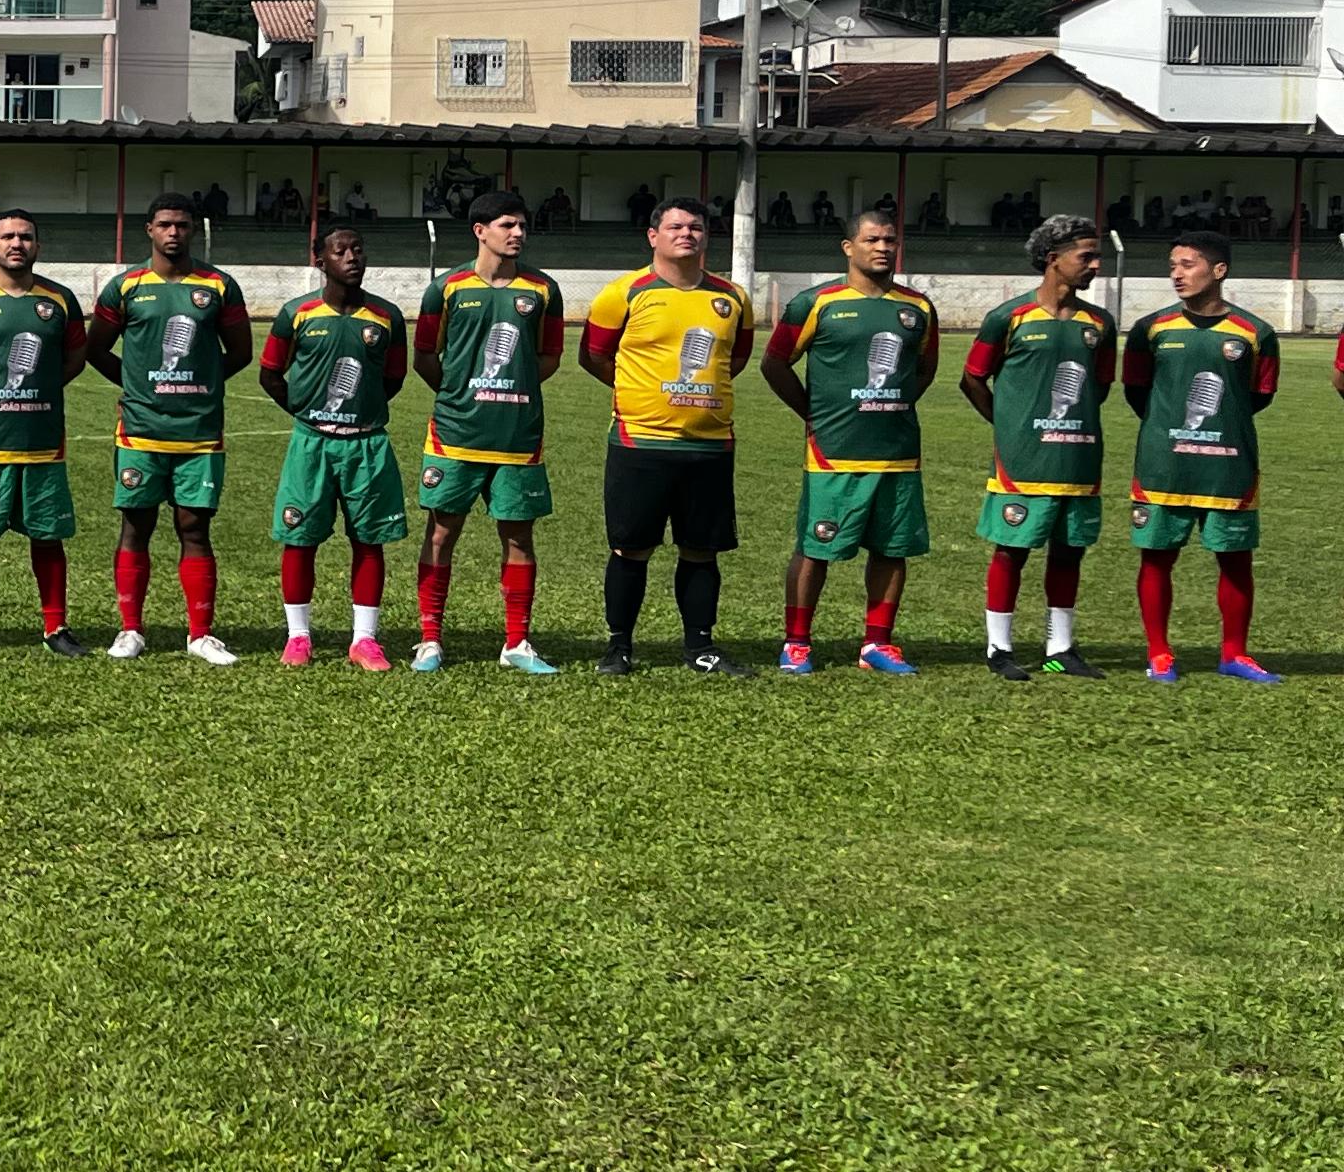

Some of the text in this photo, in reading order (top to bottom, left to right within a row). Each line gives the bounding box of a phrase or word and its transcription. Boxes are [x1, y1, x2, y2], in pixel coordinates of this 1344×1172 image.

[148, 370, 194, 381] PODCAST
[468, 378, 515, 390] PODCAST
[661, 381, 713, 394] PODCAST
[851, 388, 901, 399] PODCAST
[0, 401, 20, 412] JOÃO
[309, 409, 357, 423] PODCAST
[1033, 418, 1083, 430] PODCAST
